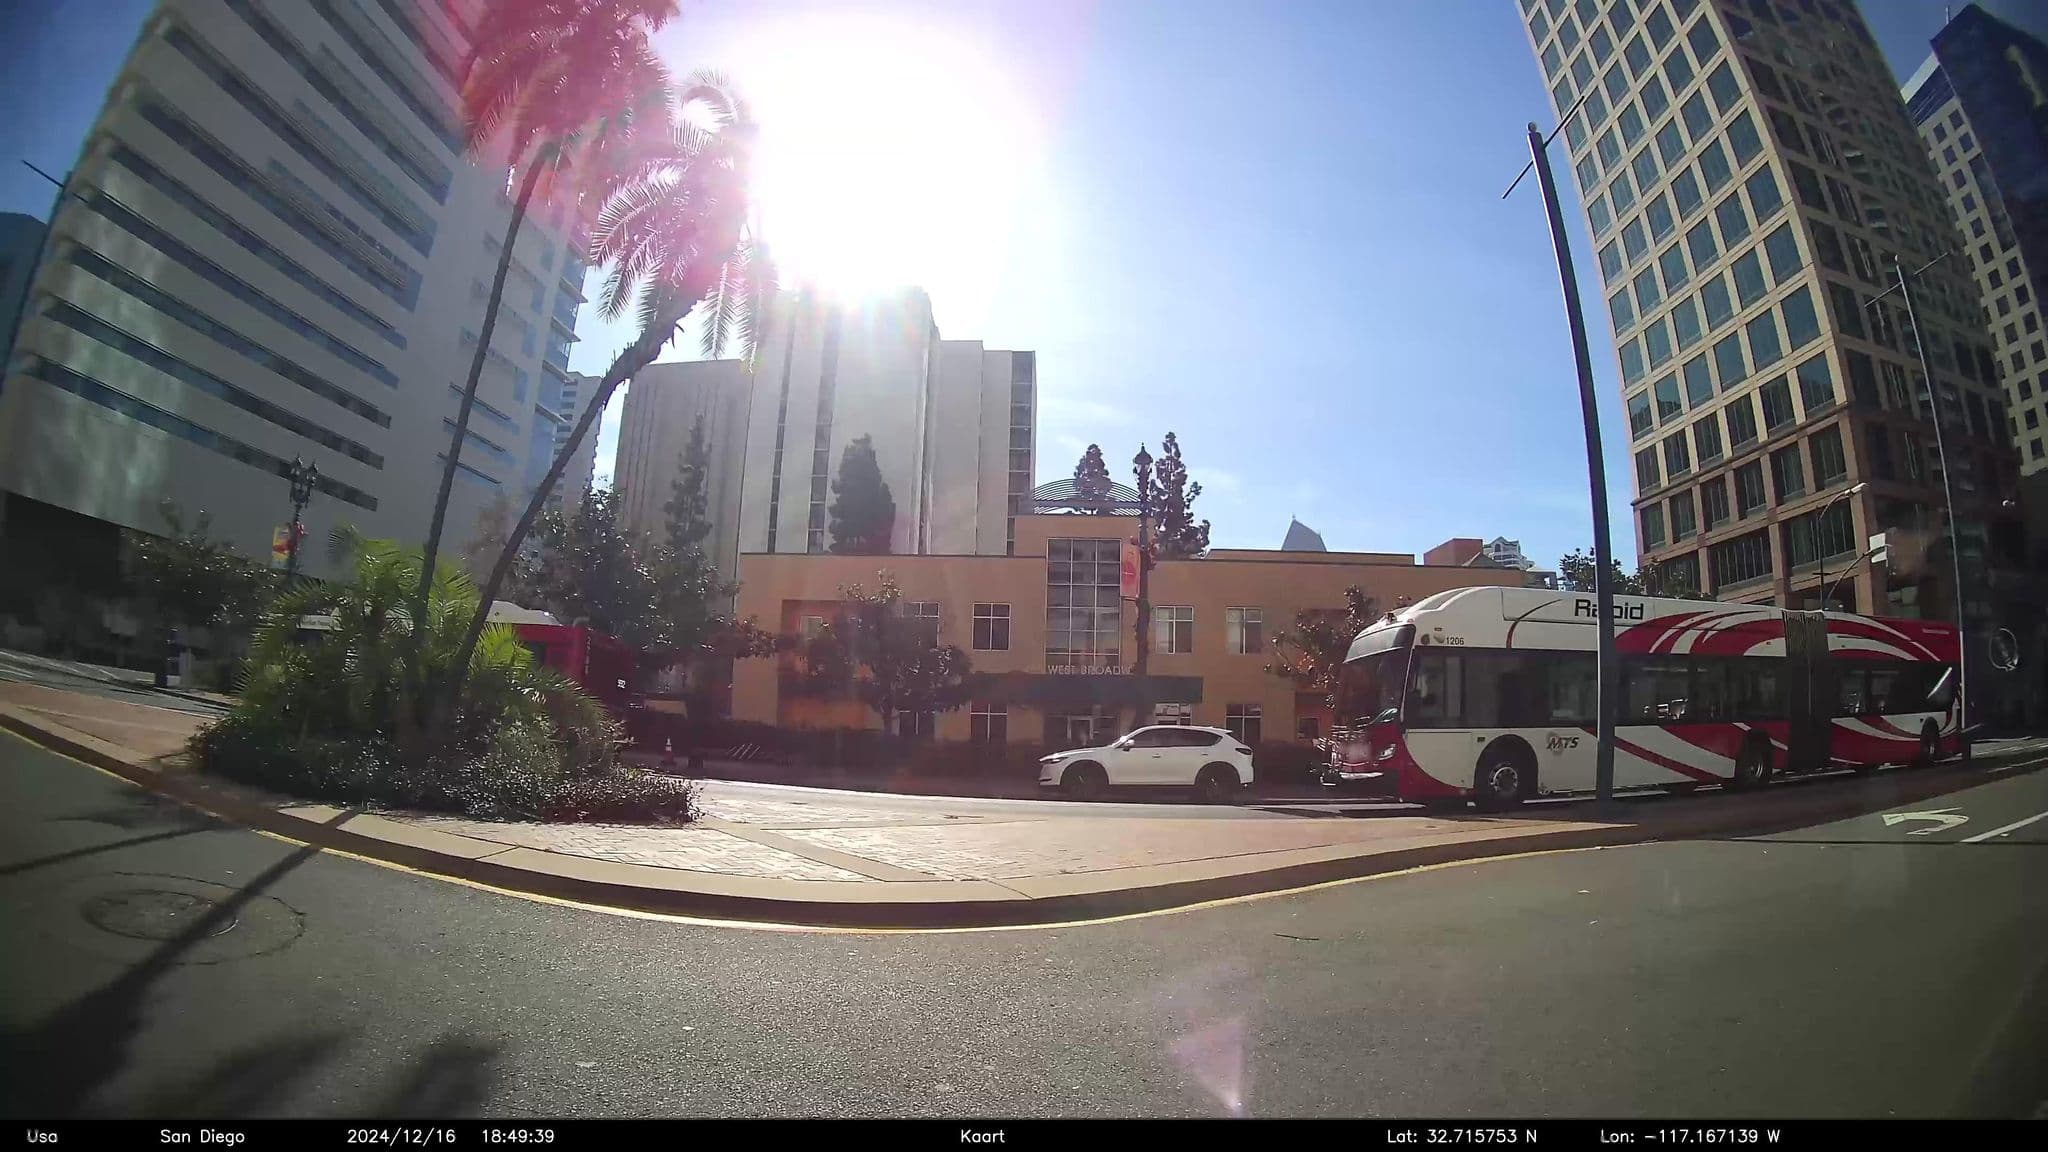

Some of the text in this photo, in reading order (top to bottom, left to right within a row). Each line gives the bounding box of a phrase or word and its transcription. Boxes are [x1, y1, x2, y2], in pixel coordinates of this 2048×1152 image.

[1446, 637, 1465, 646] 1206
[1048, 665, 1135, 675] WEST BROADW
[1546, 736, 1579, 749] MTS
